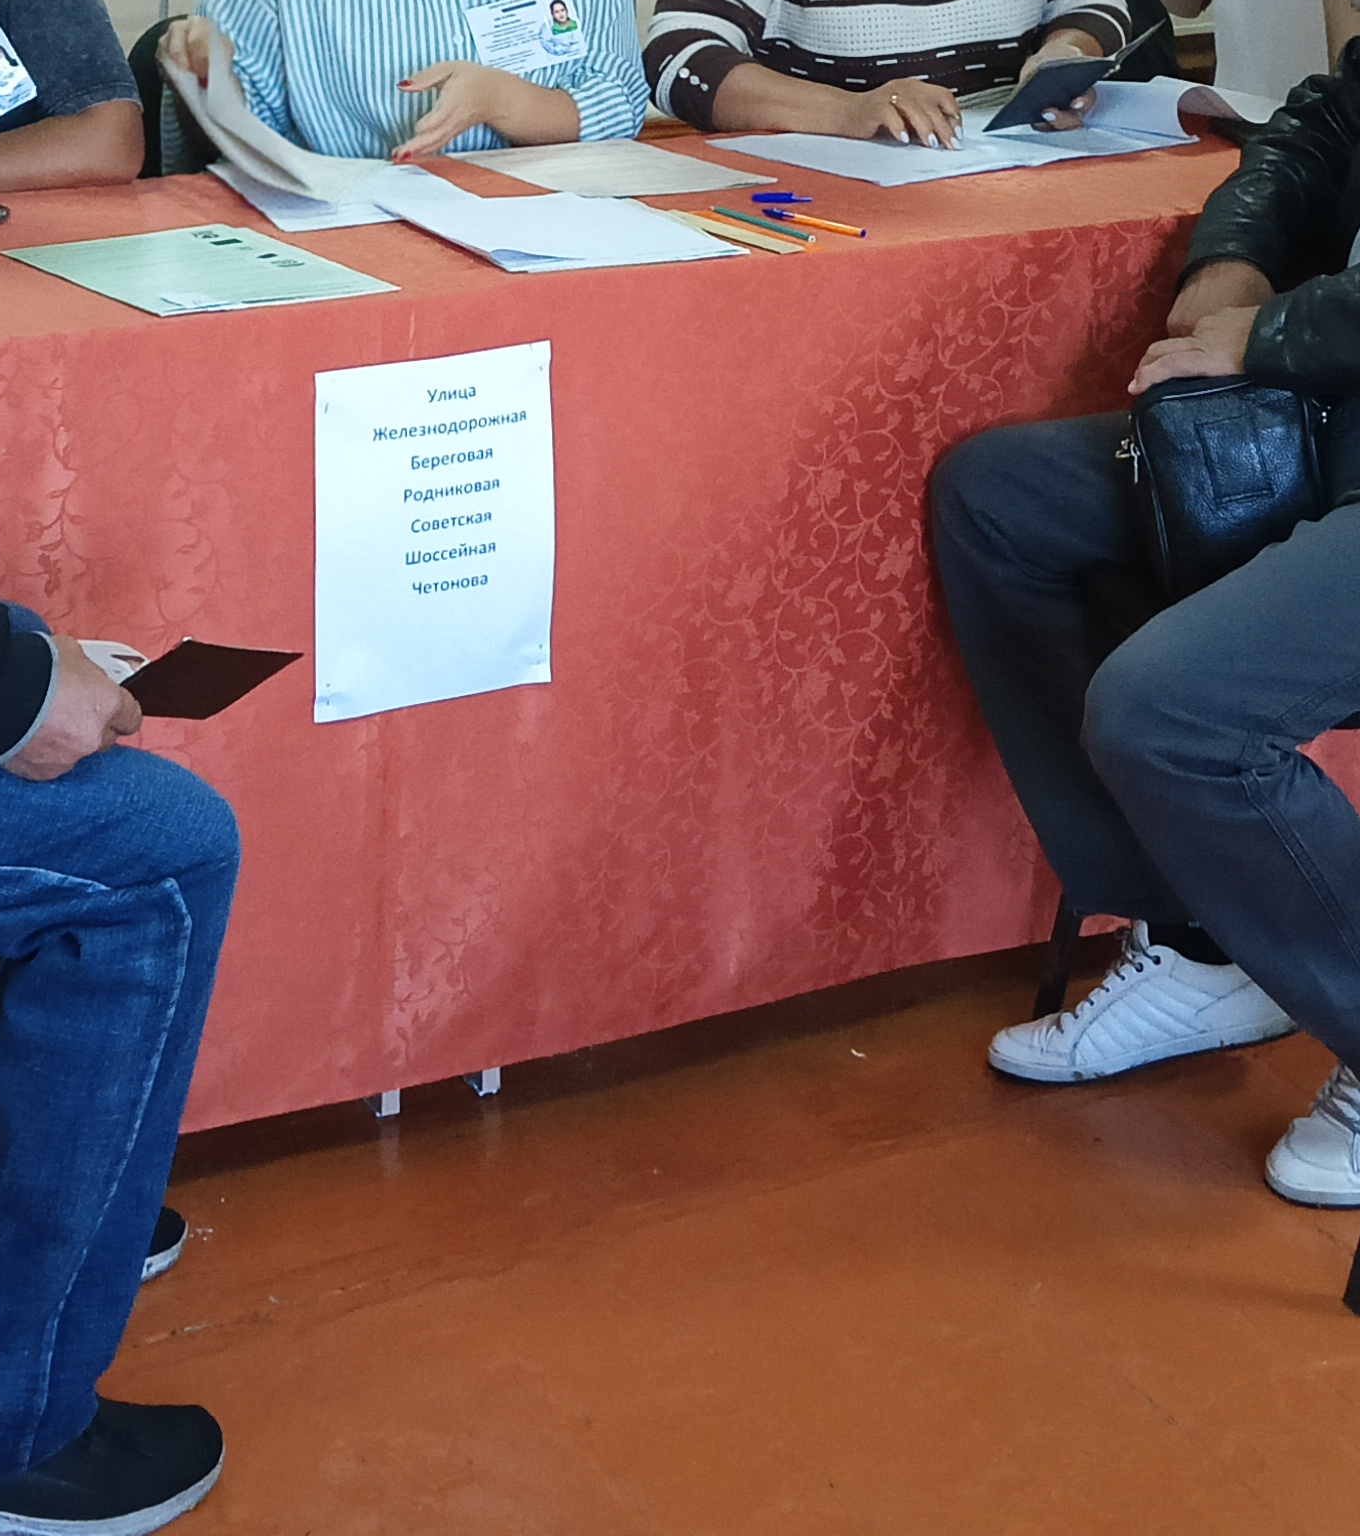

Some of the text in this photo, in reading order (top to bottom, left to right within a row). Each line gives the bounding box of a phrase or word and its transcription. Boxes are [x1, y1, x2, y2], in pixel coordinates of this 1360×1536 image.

[427, 386, 477, 403] Улица
[372, 410, 527, 442] Железнодорожная
[411, 448, 493, 470] Береговая
[403, 478, 500, 504] Родниковая
[410, 511, 492, 533] Советская
[405, 541, 497, 566] Шоссейная
[412, 574, 489, 595] Четонова
